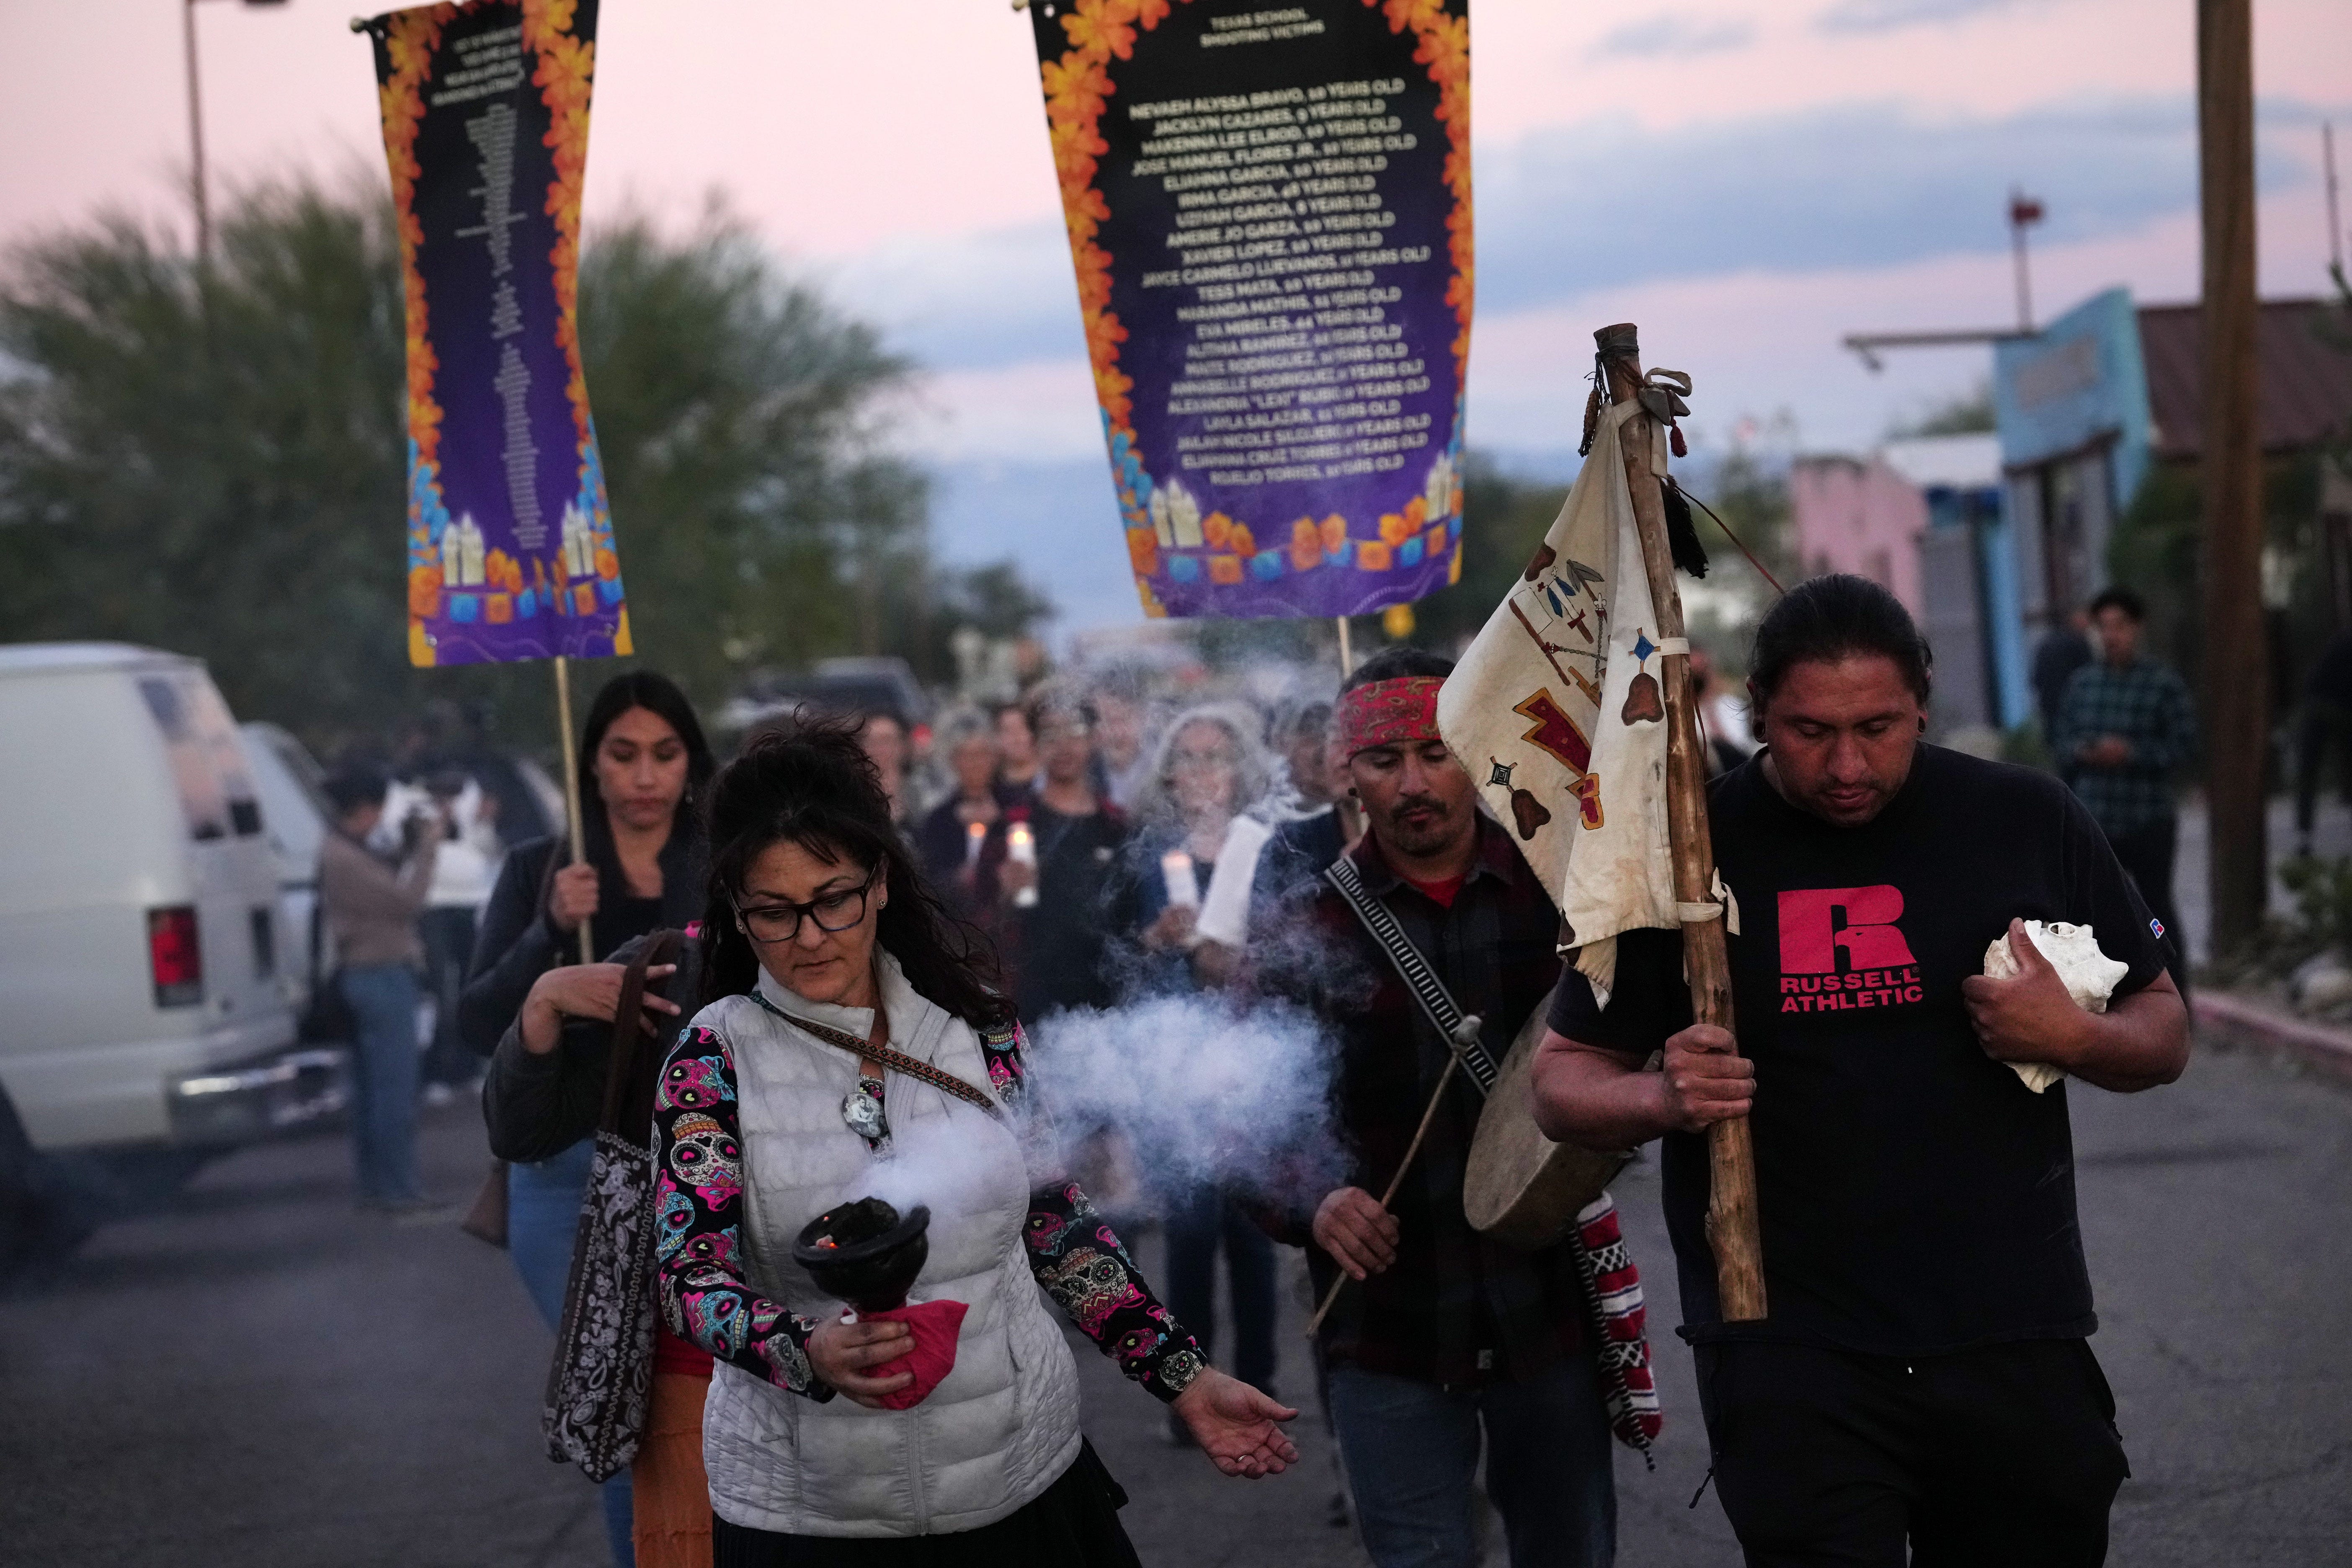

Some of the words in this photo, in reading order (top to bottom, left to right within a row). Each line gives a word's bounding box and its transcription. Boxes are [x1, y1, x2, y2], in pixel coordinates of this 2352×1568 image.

[1210, 13, 1252, 31] TEXAS
[1253, 7, 1309, 25] SCHOOL
[1199, 27, 1271, 47] SHOOTING
[1271, 20, 1325, 39] VICTIMS
[1328, 81, 1370, 97] YEARS
[1372, 79, 1405, 95] OLD
[1309, 101, 1353, 117] YEARS
[1355, 99, 1385, 115] OLD
[1218, 131, 1246, 147] LEE
[1326, 119, 1367, 136] YEARS
[1369, 116, 1401, 132] OLD
[1132, 157, 1166, 175] JOSE
[1235, 145, 1293, 165] FLORES
[1385, 134, 1416, 150] OLD
[1313, 157, 1355, 174] YEARS
[1357, 156, 1387, 171] OLD
[1301, 178, 1345, 196] YEARS
[1346, 176, 1375, 191] OLD
[1309, 196, 1351, 213] YEARS
[1353, 194, 1381, 209] OLD
[1225, 226, 1243, 241] JO
[1323, 214, 1361, 231] YEARS
[1362, 212, 1395, 228] OLD
[1311, 234, 1352, 250] YEARS
[1354, 232, 1382, 247] OLD
[1401, 246, 1430, 262] OLD
[1198, 283, 1234, 301] TESS
[1304, 272, 1347, 289] YEARS
[1349, 271, 1375, 286] OLD
[1369, 286, 1401, 302] OLD
[1354, 307, 1384, 322] OLD
[1369, 323, 1401, 340] OLD
[1375, 342, 1408, 358] OLD
[1349, 361, 1395, 378] YEARS
[1398, 358, 1424, 374] OLD
[1356, 379, 1403, 395] YEARS
[1405, 375, 1429, 391] OLD
[1369, 399, 1400, 415] OLD
[1356, 417, 1402, 434] YEARS
[1403, 414, 1431, 431] OLD
[1356, 436, 1397, 453] YEARS
[1399, 433, 1428, 450] OLD
[1376, 454, 1404, 471] OLD
[1780, 968, 1921, 993] RUSSELL
[1781, 985, 1923, 1013] ATHLETIC
